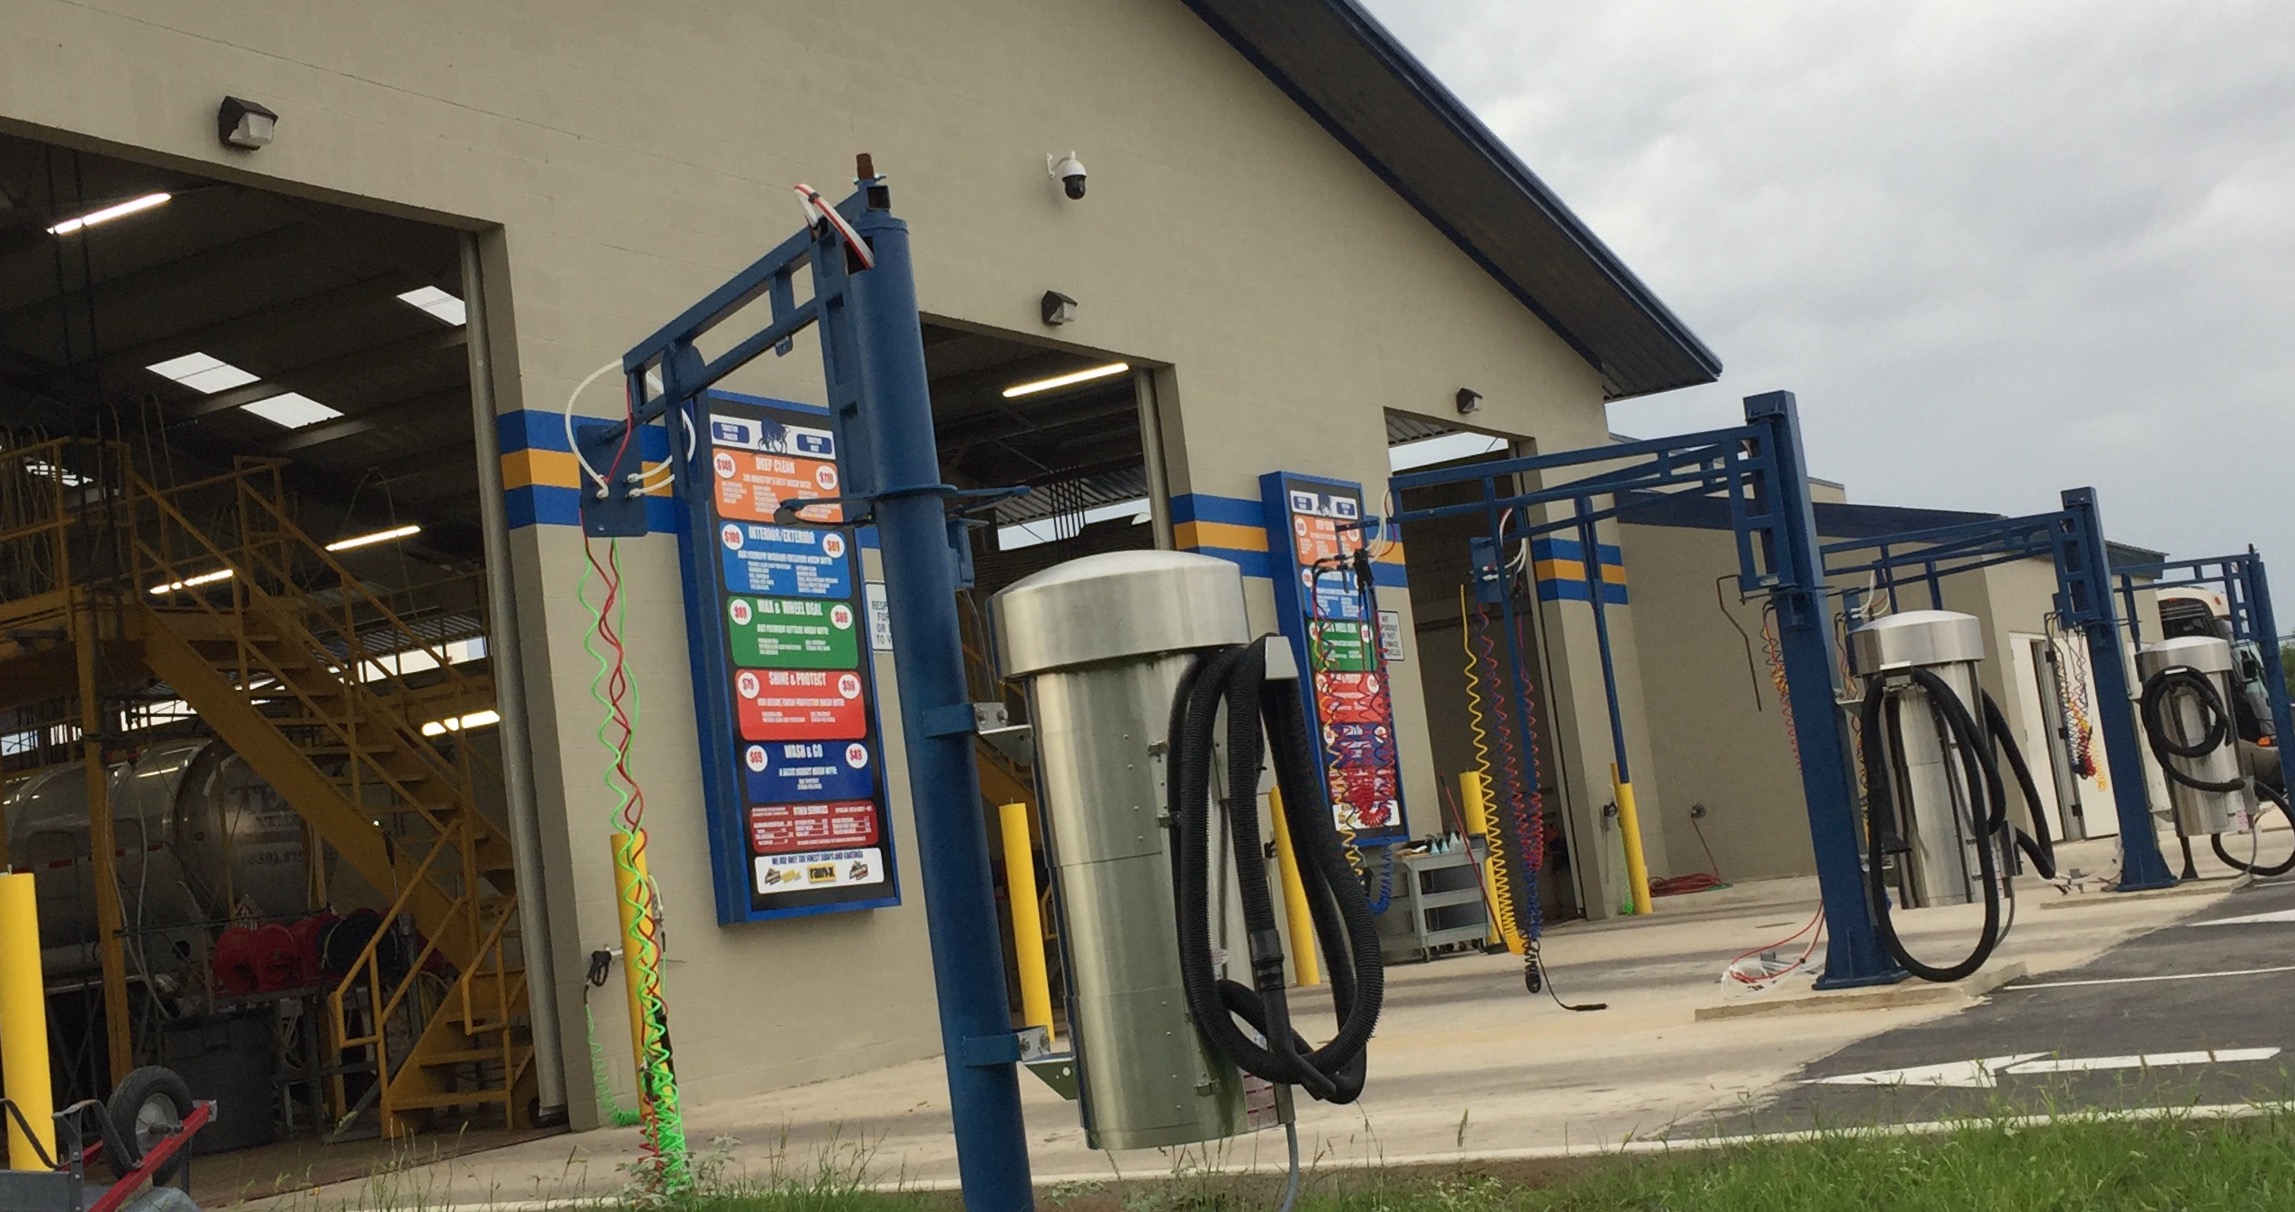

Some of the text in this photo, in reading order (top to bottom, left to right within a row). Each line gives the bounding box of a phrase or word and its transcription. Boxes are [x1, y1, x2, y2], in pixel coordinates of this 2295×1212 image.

[756, 457, 795, 474] DEEP CLEAN
[749, 526, 816, 544] INTERIOR/EXTERIOR
[757, 599, 774, 613] WAX
[782, 600, 805, 615] WHEEL
[805, 602, 823, 616] DEAL
[768, 671, 789, 685] SHINE
[796, 672, 826, 686] PROTECT
[783, 744, 806, 759] WASH
[812, 743, 823, 757] GO
[849, 749, 862, 761] $49
